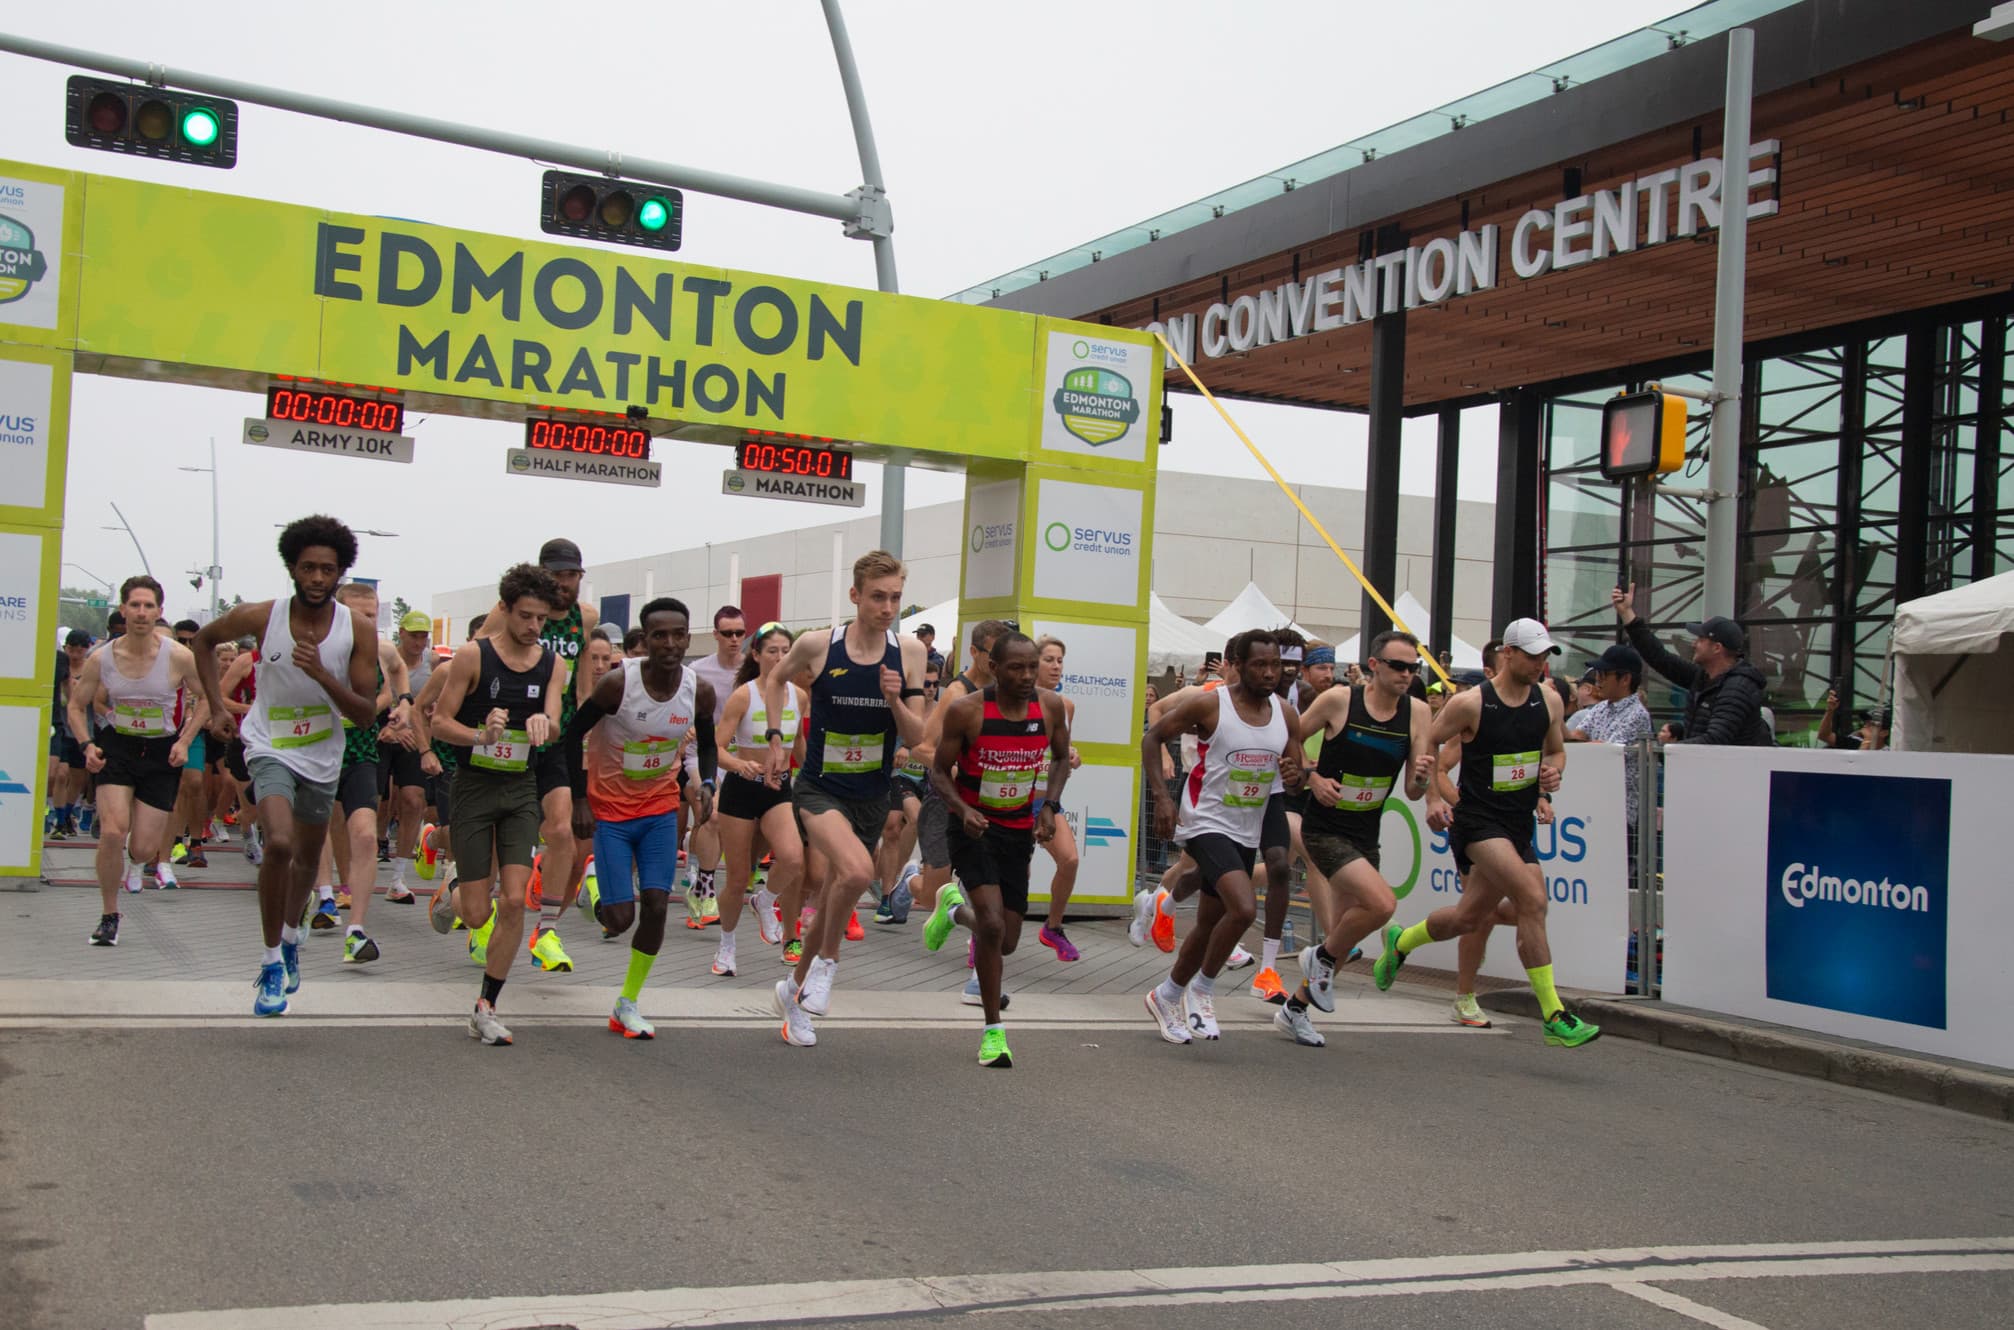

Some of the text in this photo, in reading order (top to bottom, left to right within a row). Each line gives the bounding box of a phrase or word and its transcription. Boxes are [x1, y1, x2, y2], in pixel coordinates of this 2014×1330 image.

[1201, 223, 1498, 358] CONVENTION
[1511, 138, 1781, 278] CENTRE
[314, 222, 864, 367] EDMONTON
[1091, 344, 1127, 357] servus
[397, 324, 787, 420] MARATHON
[1064, 392, 1131, 411] EDMONTON
[272, 390, 398, 432] 00:00:00
[1072, 405, 1121, 419] MARATHON
[291, 430, 394, 456] ARMY 10K
[532, 422, 645, 458] 00:00:00
[533, 457, 660, 481] HALF MARATHON
[756, 478, 854, 501] MARATHON
[985, 522, 1013, 539] servus
[1074, 527, 1131, 545] servus
[1073, 542, 1131, 556] credit union
[1065, 674, 1127, 688] HEALTHCARE
[1064, 684, 1127, 698] SOLUTIONS
[131, 719, 146, 728] 44
[669, 713, 689, 725] iten
[293, 722, 311, 736] 47
[494, 746, 512, 759] 33
[844, 750, 863, 762] 23
[643, 758, 660, 768] 48
[1511, 769, 1525, 780] 28
[1000, 787, 1017, 798] 50
[1242, 785, 1260, 797] 29
[1356, 791, 1373, 802] 40
[1430, 816, 1587, 862] sus
[1781, 862, 1929, 912] Edmonton
